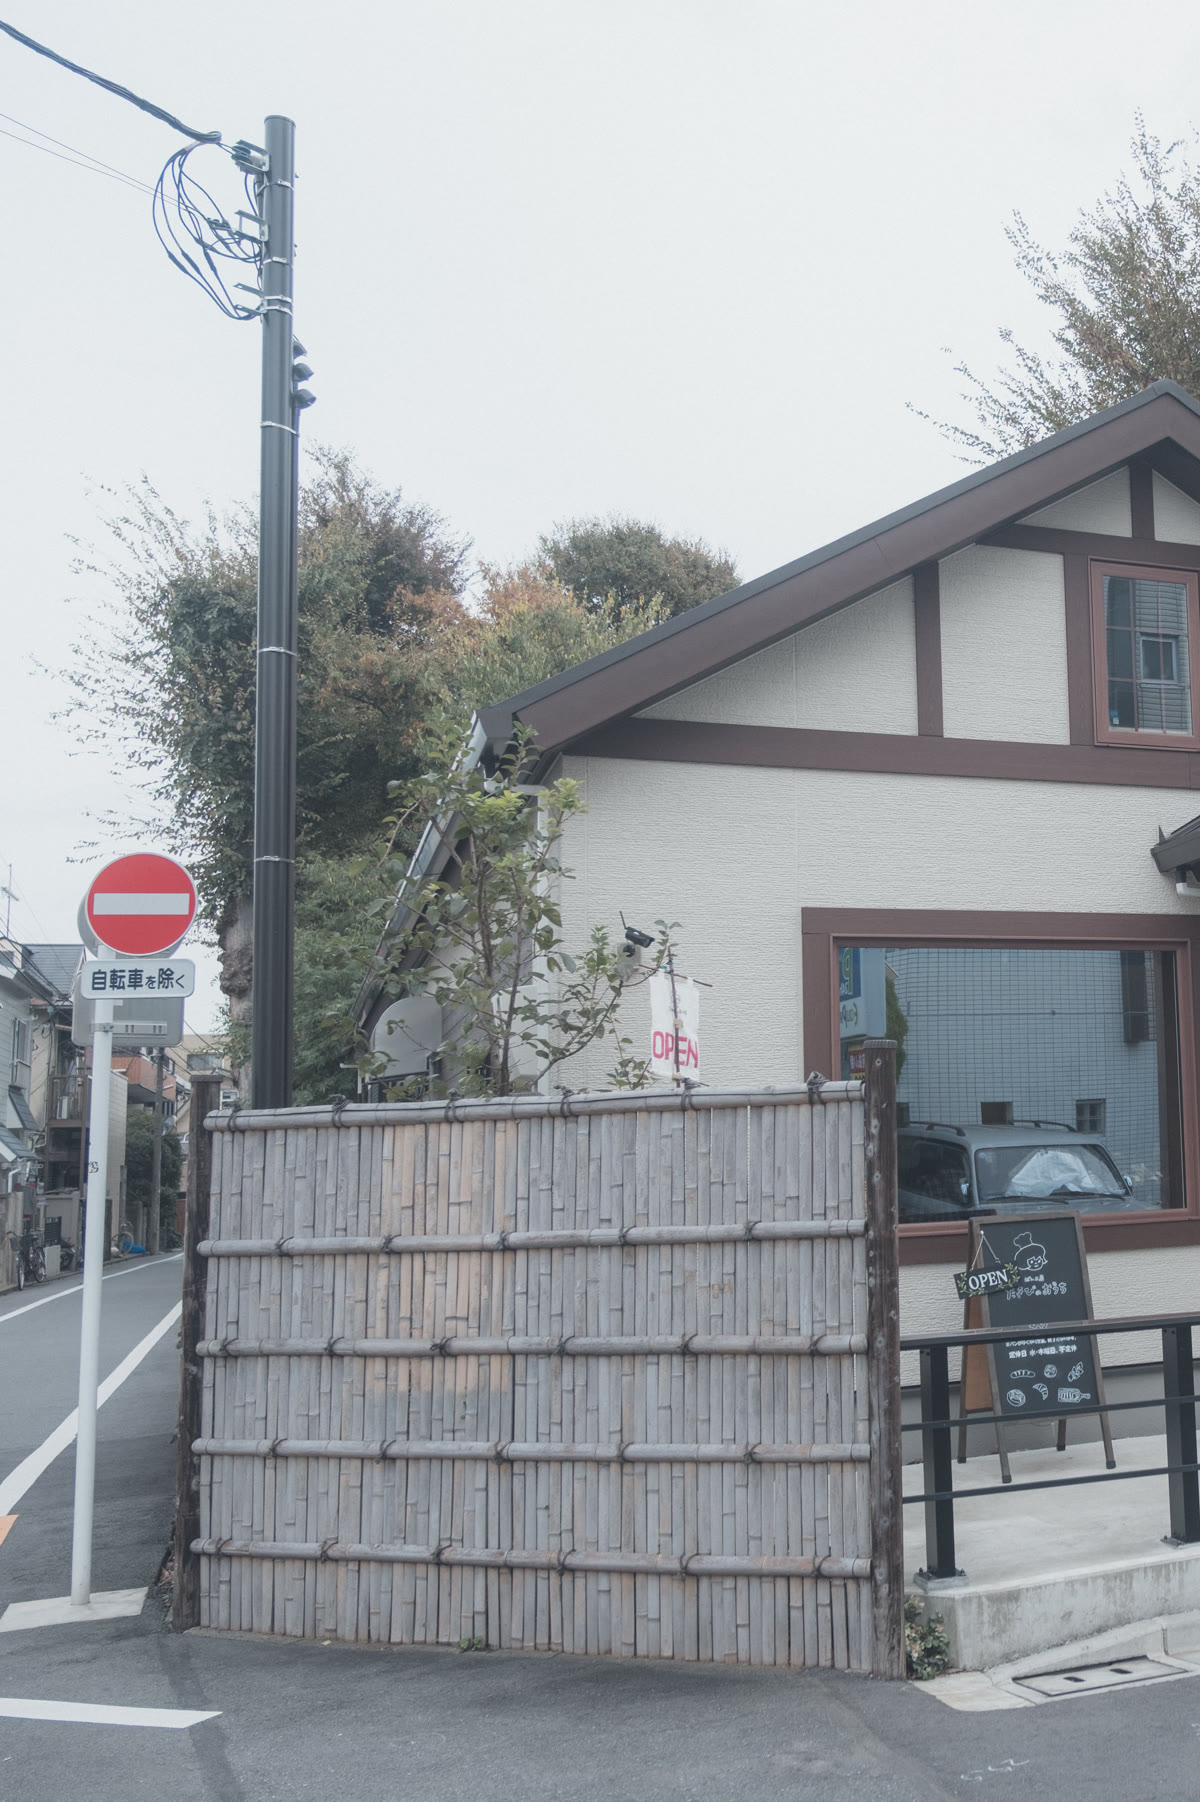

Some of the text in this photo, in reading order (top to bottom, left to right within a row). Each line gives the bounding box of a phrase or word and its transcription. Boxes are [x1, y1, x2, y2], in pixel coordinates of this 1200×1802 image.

[91, 967, 185, 991] 自転車を除く
[653, 1031, 698, 1068] OPEN
[968, 1269, 1007, 1290] OPEN
[1009, 1350, 1027, 1358] 定休日
